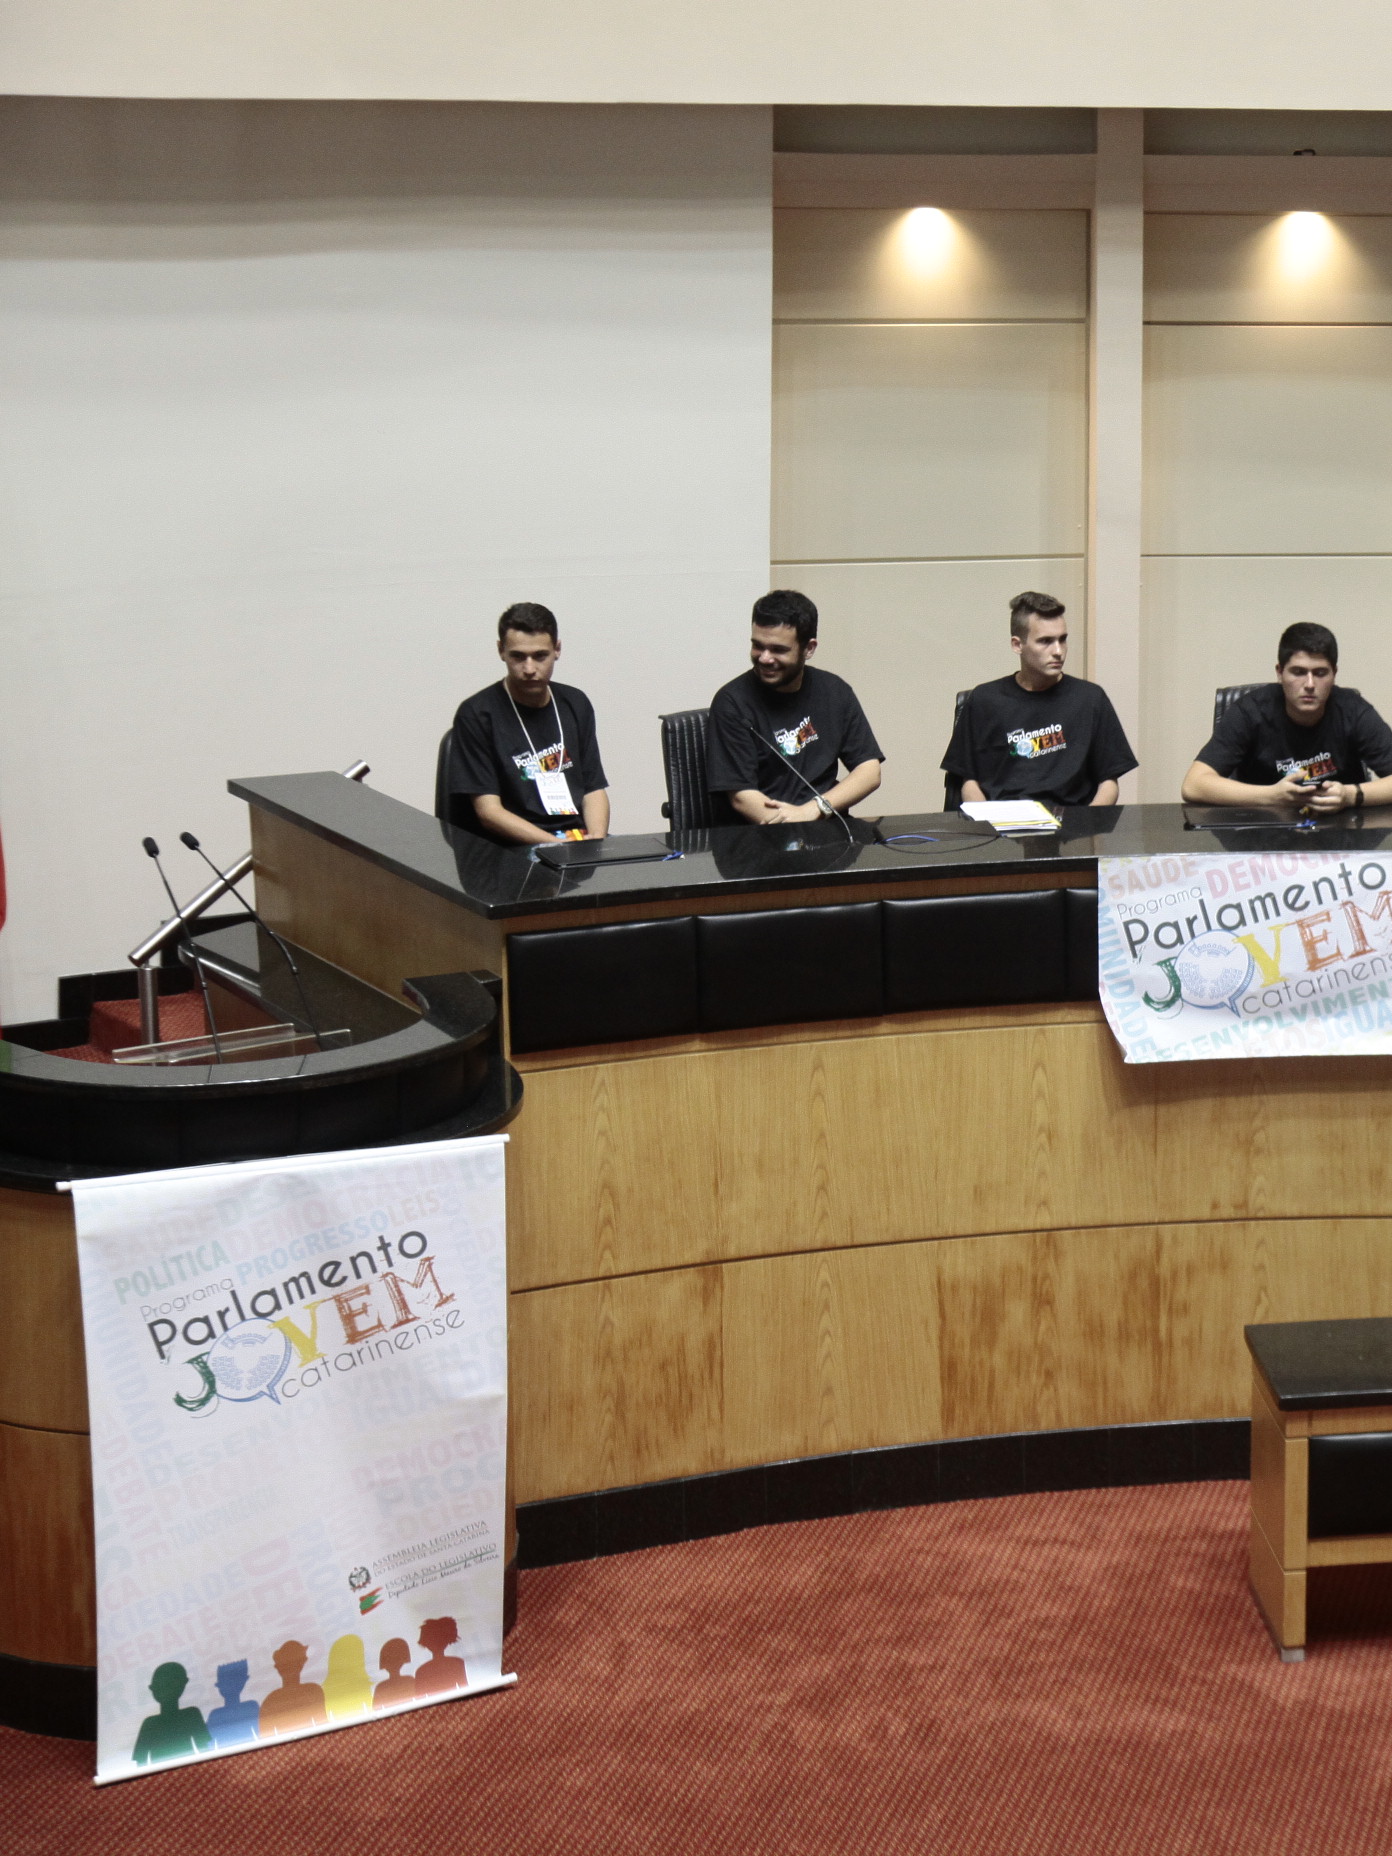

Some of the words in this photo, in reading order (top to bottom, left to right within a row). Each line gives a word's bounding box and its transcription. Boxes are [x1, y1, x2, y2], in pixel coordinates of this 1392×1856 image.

[1008, 724, 1062, 744] Parlamento
[1116, 886, 1203, 919] Programa
[1123, 862, 1387, 959] Parlamento
[113, 1239, 231, 1305] POLÍTICA
[235, 1209, 389, 1287] PROGRESSO
[139, 1278, 235, 1322] Programa
[146, 1230, 428, 1362] Parlamento
[173, 1255, 456, 1419] JOVEM
[281, 1309, 465, 1399] catarinense
[372, 1541, 428, 1568] ASSEMBLEIA
[429, 1520, 487, 1548] LEGISLATIVA
[453, 1528, 490, 1547] CATARINA
[385, 1569, 420, 1591] ESCOLA
[421, 1563, 438, 1577] DO
[439, 1542, 498, 1569] LEGISLATIVO
